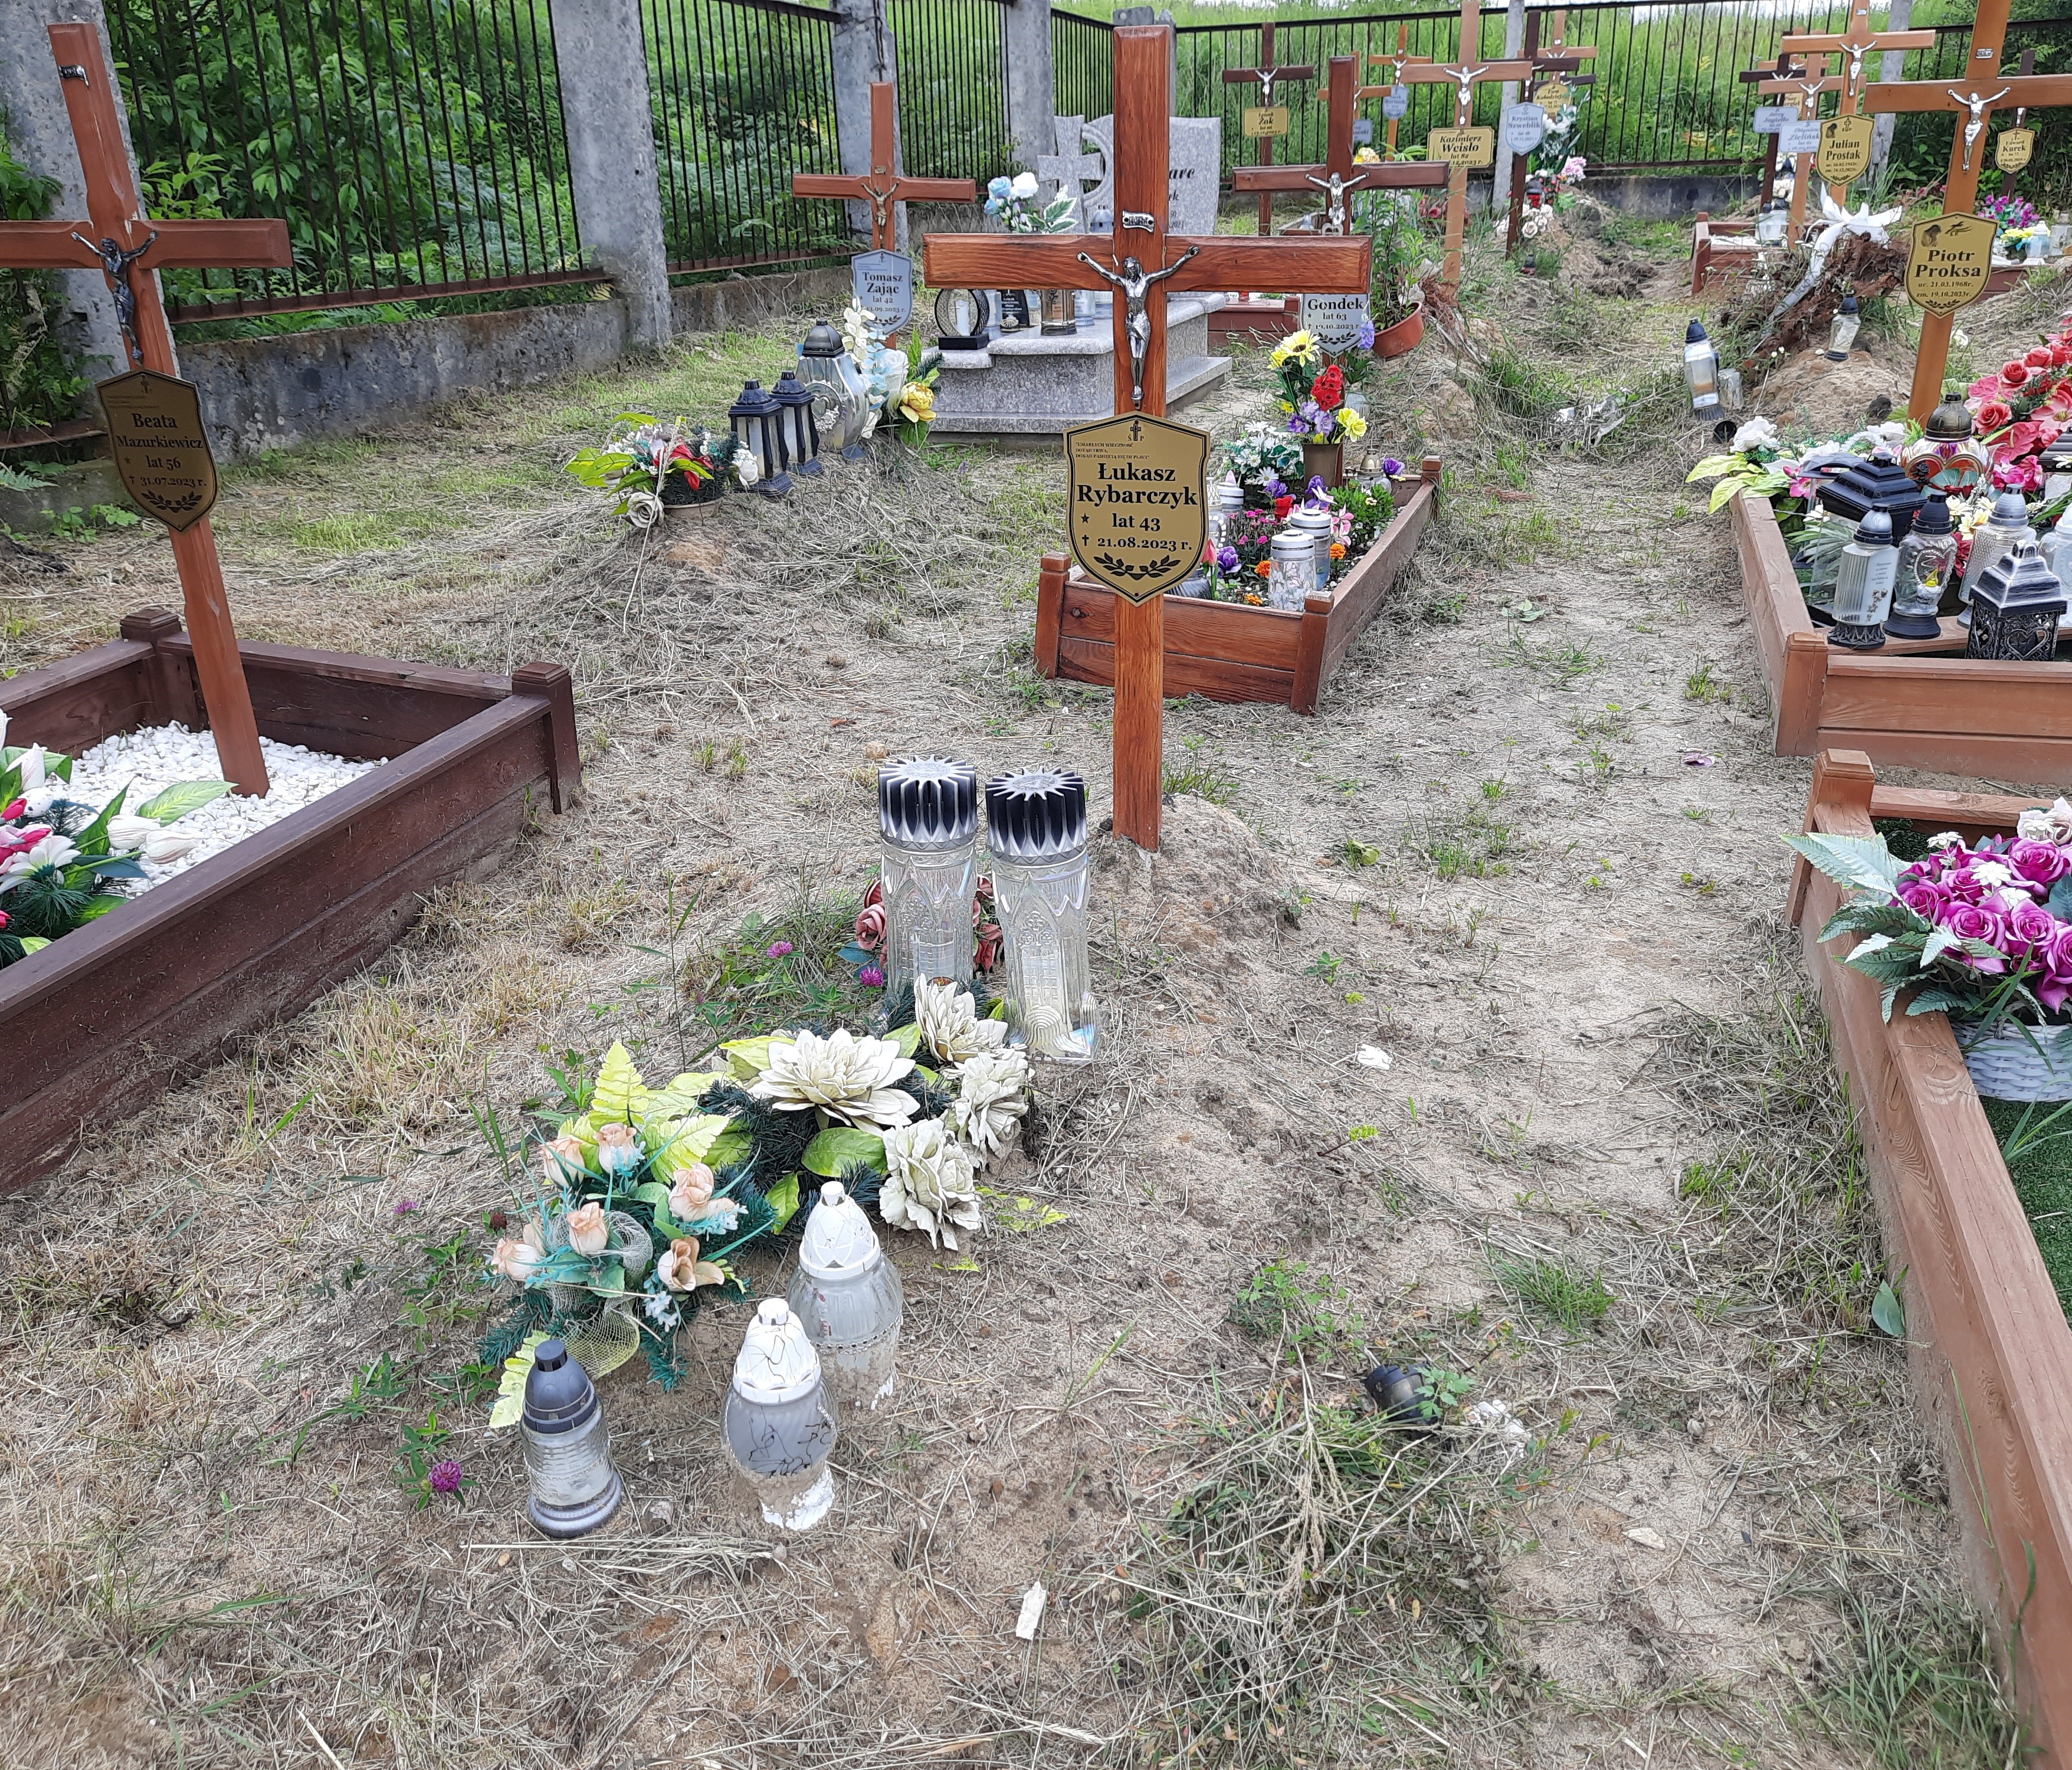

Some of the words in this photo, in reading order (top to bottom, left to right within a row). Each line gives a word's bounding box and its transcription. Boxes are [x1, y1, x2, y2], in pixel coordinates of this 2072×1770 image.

[1440, 135, 1483, 143] Kazimierz
[1788, 133, 1819, 141] Zielińsk
[1829, 139, 1860, 149] Julian
[1826, 149, 1861, 160] Prostak
[1927, 250, 1975, 262] Piotr
[862, 272, 903, 282] Tomasz
[1914, 264, 1981, 278] Proksa
[867, 282, 899, 296] Zając
[1307, 297, 1364, 310] Gondek
[1336, 313, 1347, 321] 63
[132, 412, 178, 428] Beata
[116, 435, 204, 448] Mazurkiewicz
[145, 455, 163, 468] lat
[166, 457, 181, 471] 56
[1097, 463, 1176, 482] Łukasz
[140, 477, 196, 487] 31.07.2023
[1077, 484, 1198, 509] Rybarczyk
[1112, 513, 1135, 528] lat
[1139, 517, 1160, 532] 43
[1097, 537, 1177, 552] 21.08.2023
[1181, 541, 1193, 550] r.
